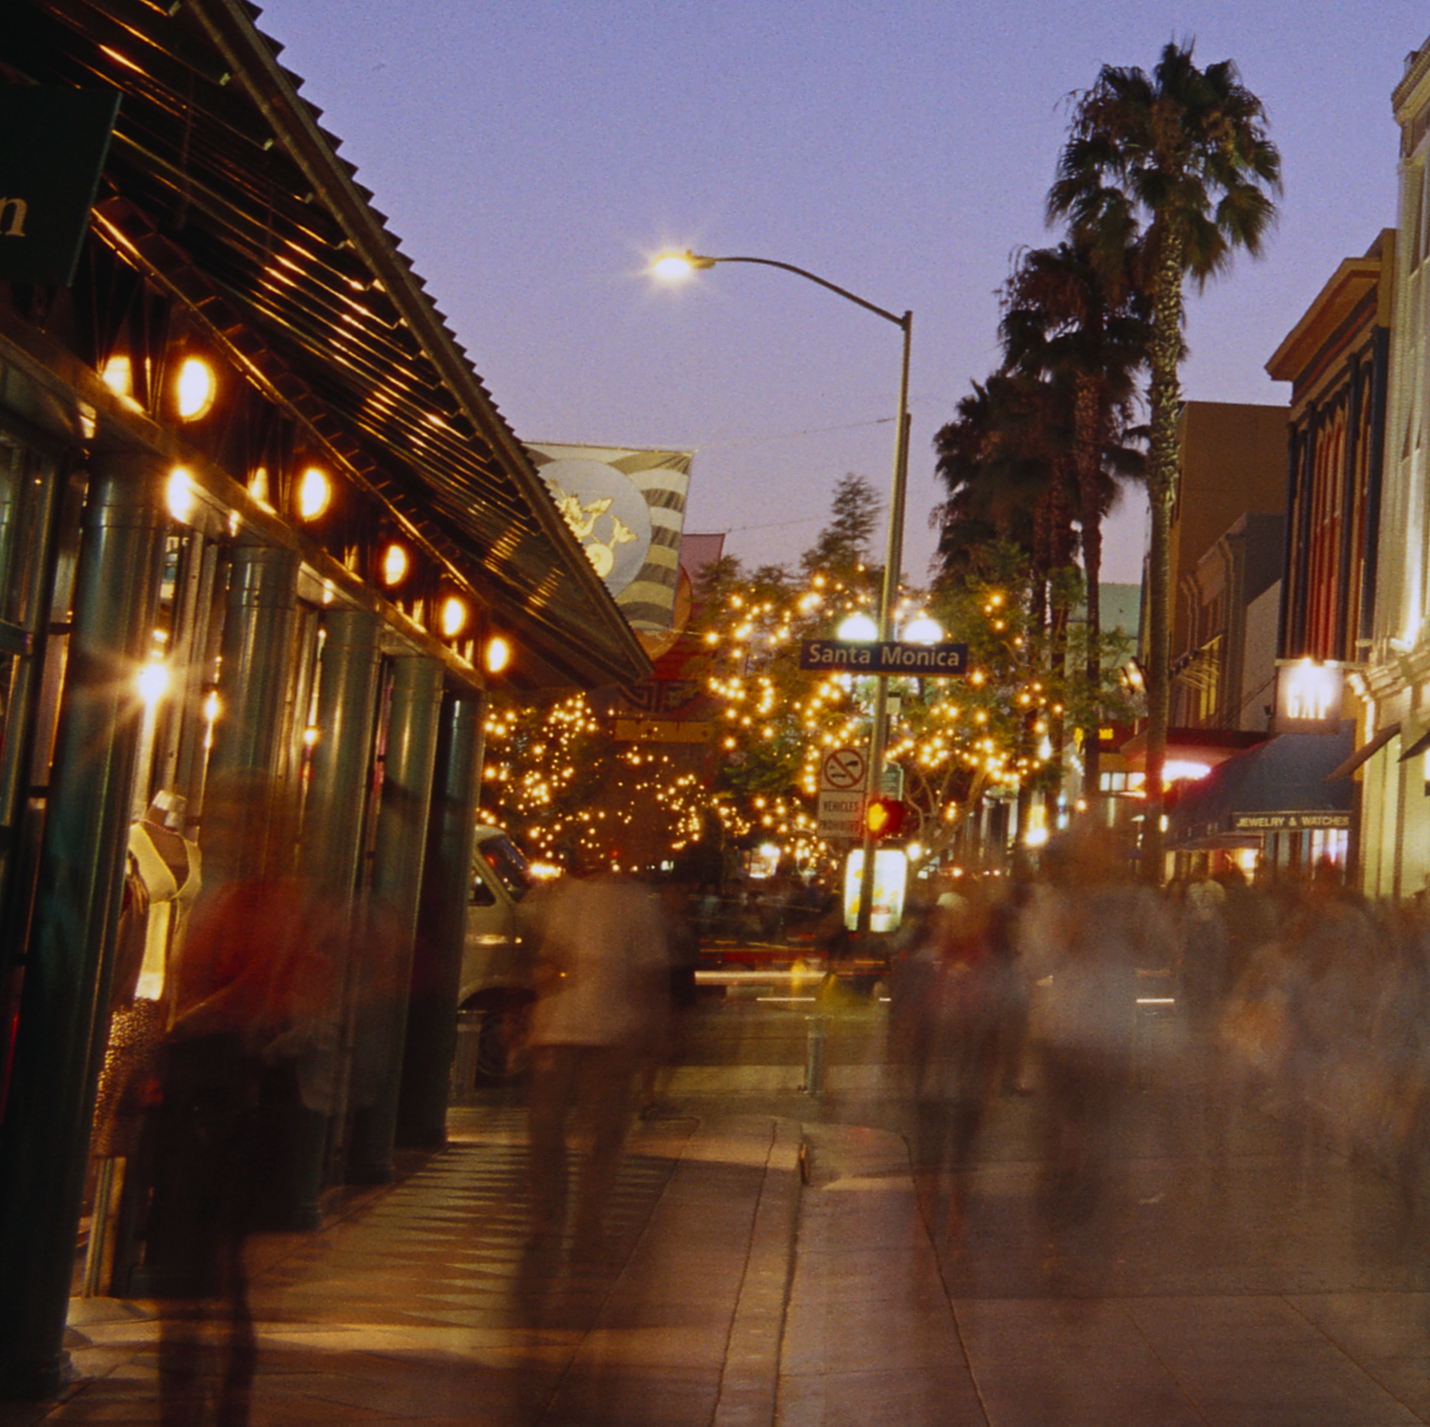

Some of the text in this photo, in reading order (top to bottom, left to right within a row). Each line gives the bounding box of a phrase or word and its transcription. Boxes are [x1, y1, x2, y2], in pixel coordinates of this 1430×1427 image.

[808, 643, 960, 666] Santa Monica
[1236, 815, 1349, 827] JEWELRY & WATCHES
